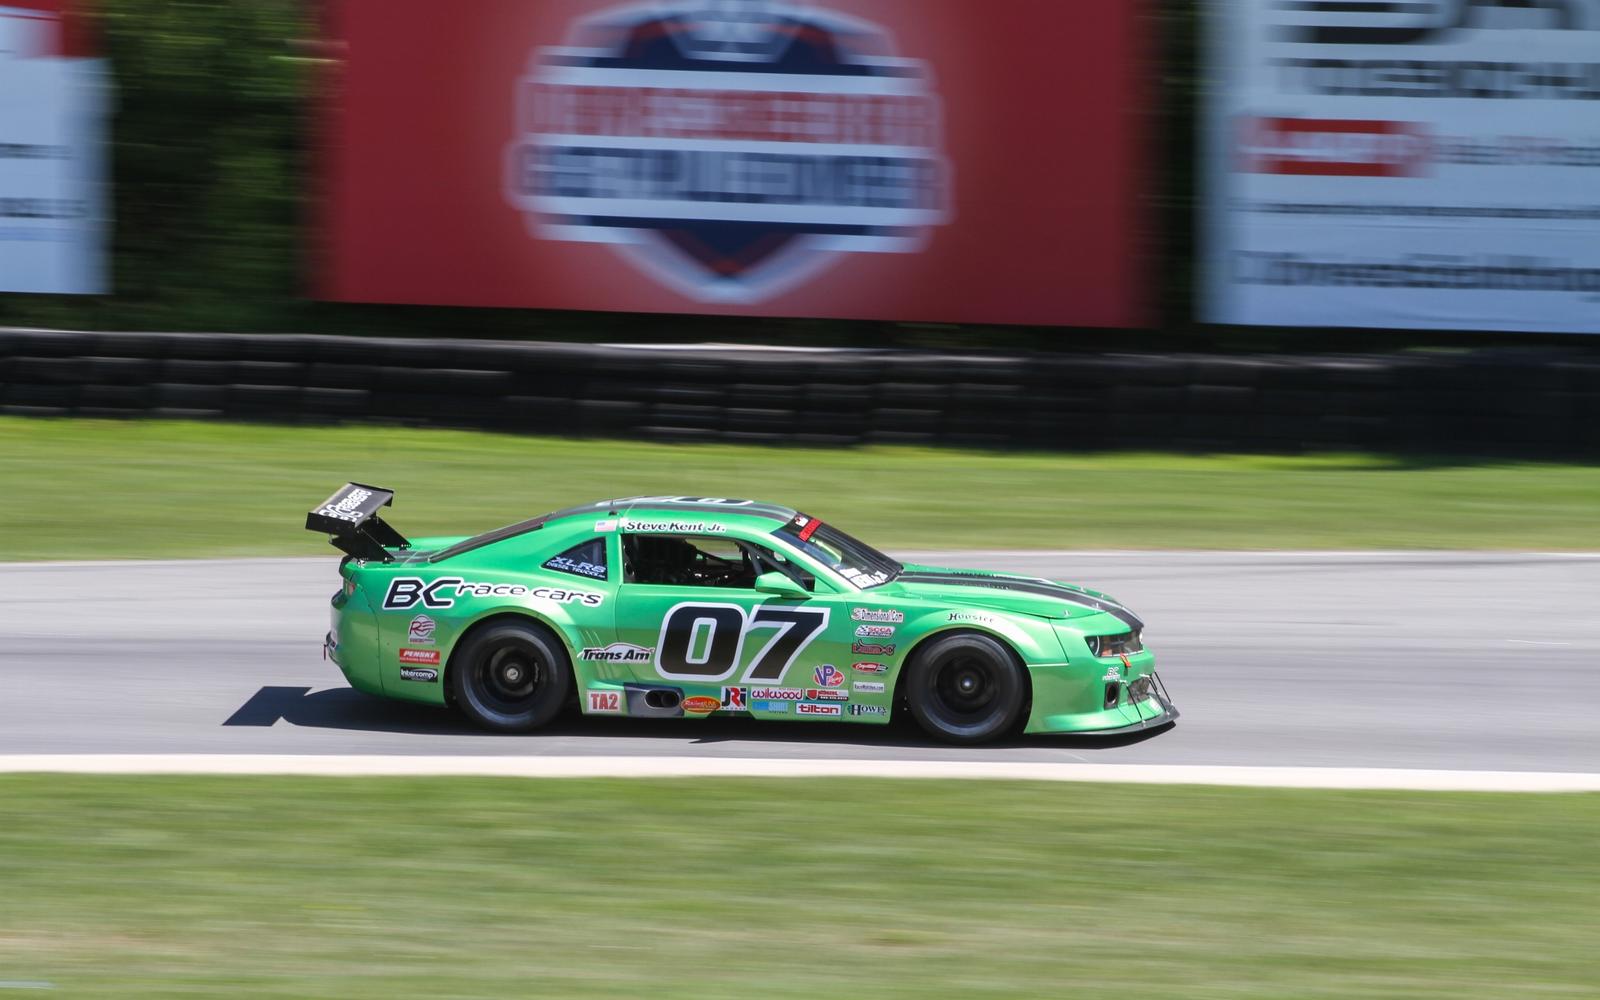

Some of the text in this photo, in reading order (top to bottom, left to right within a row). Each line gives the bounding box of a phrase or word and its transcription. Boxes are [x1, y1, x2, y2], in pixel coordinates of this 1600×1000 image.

[626, 522, 726, 532] Steve Kent Jr.
[458, 584, 526, 596] race
[532, 588, 601, 605] cars
[654, 602, 831, 684] 07
[403, 651, 436, 659] PENSKE
[583, 649, 650, 661] Trans Am
[401, 669, 434, 679] Intercomp
[815, 665, 835, 686] VP
[752, 688, 803, 700] wilwood
[590, 693, 618, 710] TA2
[798, 705, 839, 714] tilton
